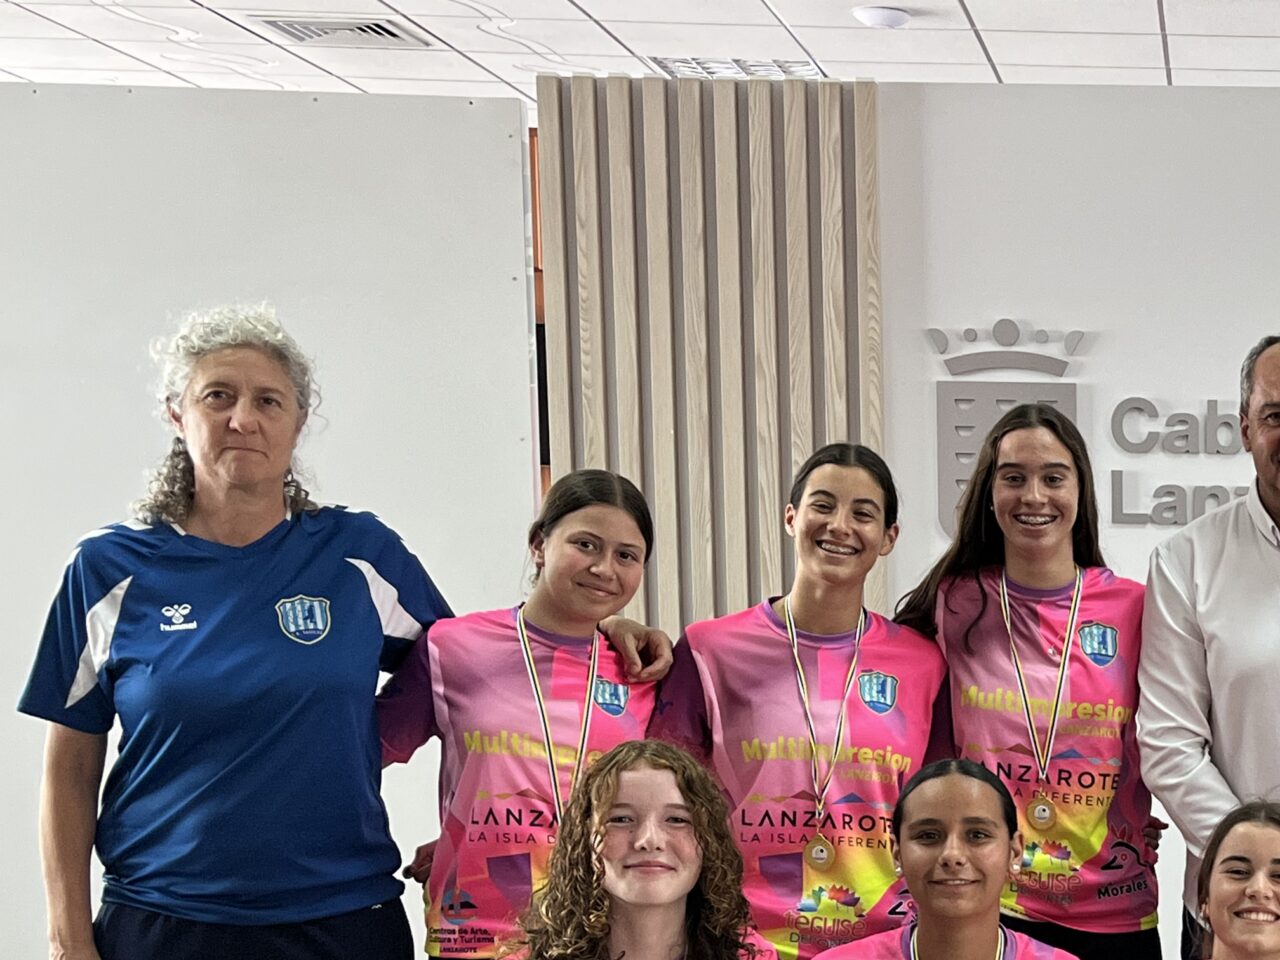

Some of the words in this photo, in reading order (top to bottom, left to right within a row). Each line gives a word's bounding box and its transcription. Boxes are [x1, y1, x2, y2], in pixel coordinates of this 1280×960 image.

[468, 831, 488, 843] LA
[495, 832, 537, 844] ISLA
[740, 832, 761, 843] LA
[770, 833, 809, 844] ISLA
[1098, 879, 1147, 899] Morales
[460, 936, 495, 944] Turismo
